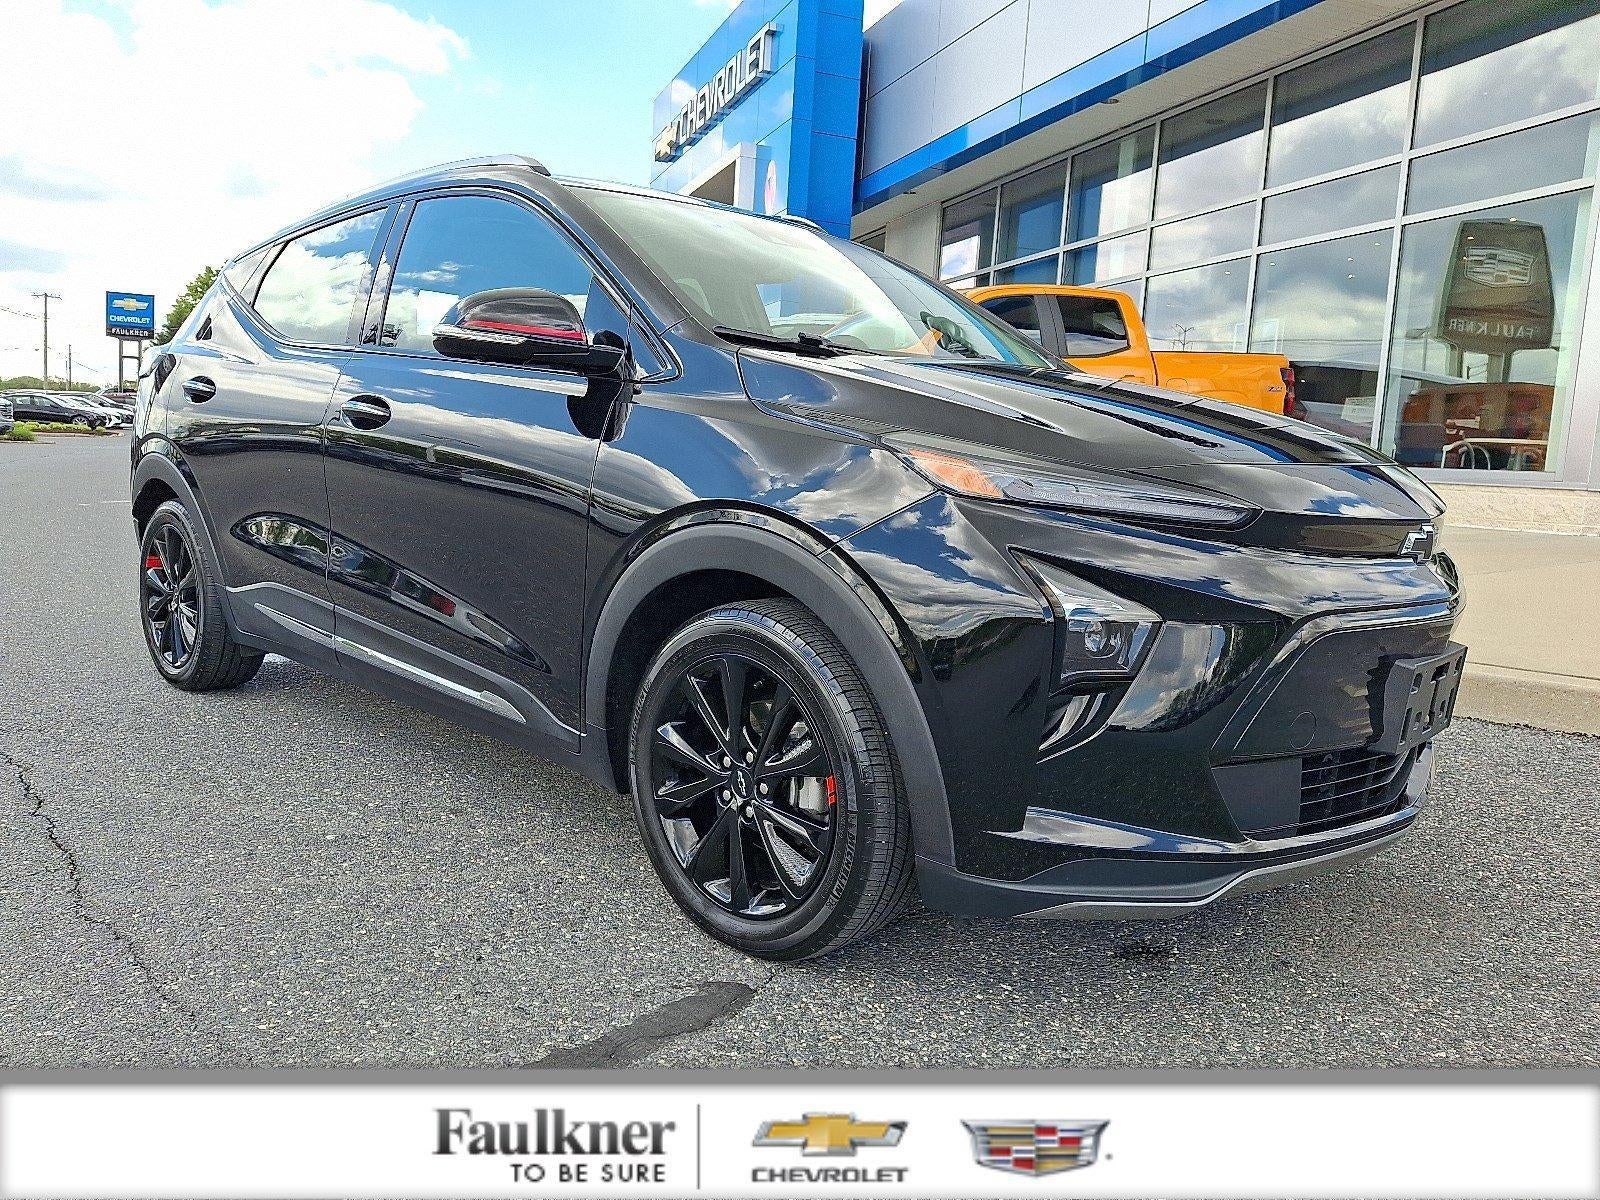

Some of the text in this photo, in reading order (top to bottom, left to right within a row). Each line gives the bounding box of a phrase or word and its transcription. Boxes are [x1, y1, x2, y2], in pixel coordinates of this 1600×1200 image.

[678, 21, 776, 146] CHEVROLET
[110, 315, 150, 323] CHEVROLET
[111, 328, 149, 336] FAULKNER
